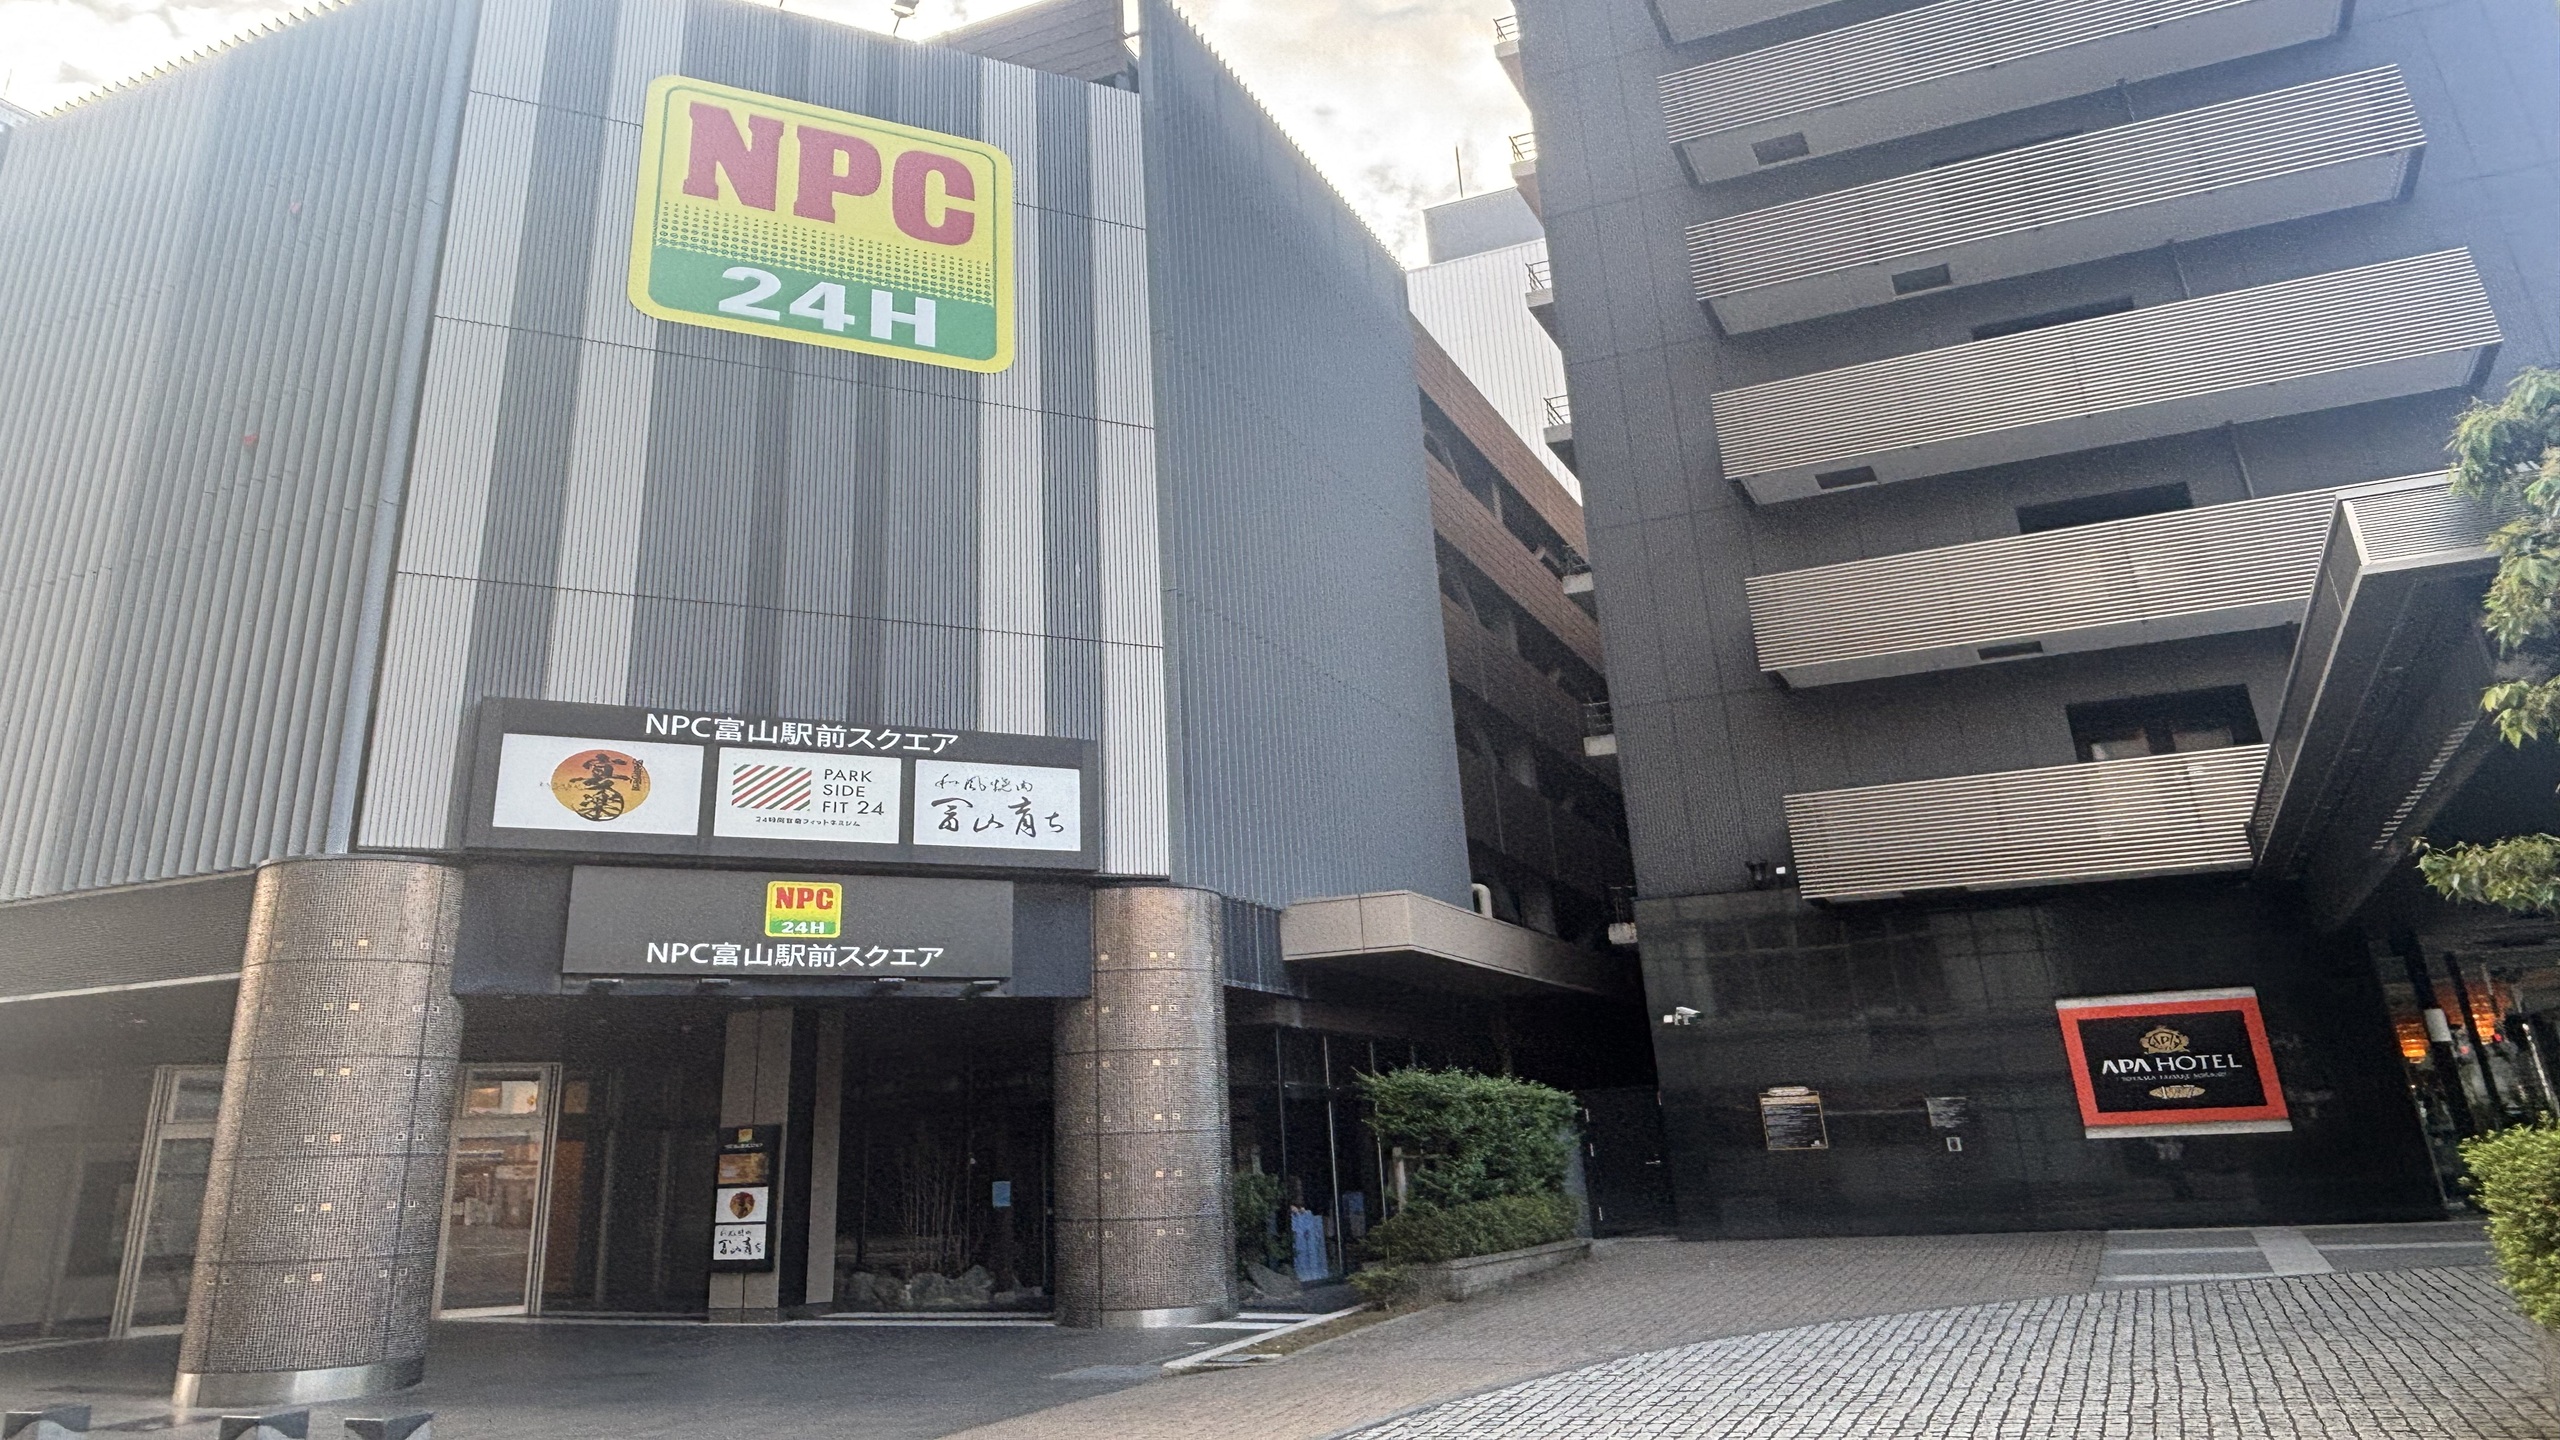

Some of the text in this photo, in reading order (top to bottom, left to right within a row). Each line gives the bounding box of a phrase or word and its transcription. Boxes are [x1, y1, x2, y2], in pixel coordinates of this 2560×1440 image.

[683, 101, 975, 247] NPC
[718, 266, 936, 348] 24H
[645, 713, 958, 753] NPC富山駅前スクエア
[824, 769, 872, 782] PARK
[823, 784, 865, 798] SIDE
[823, 800, 885, 815] FIT 24
[775, 887, 834, 910] NPC
[781, 921, 825, 934] 24H
[647, 942, 944, 968] NPC富山駅前スクエア
[2101, 1054, 2243, 1075] APA HOTEL
